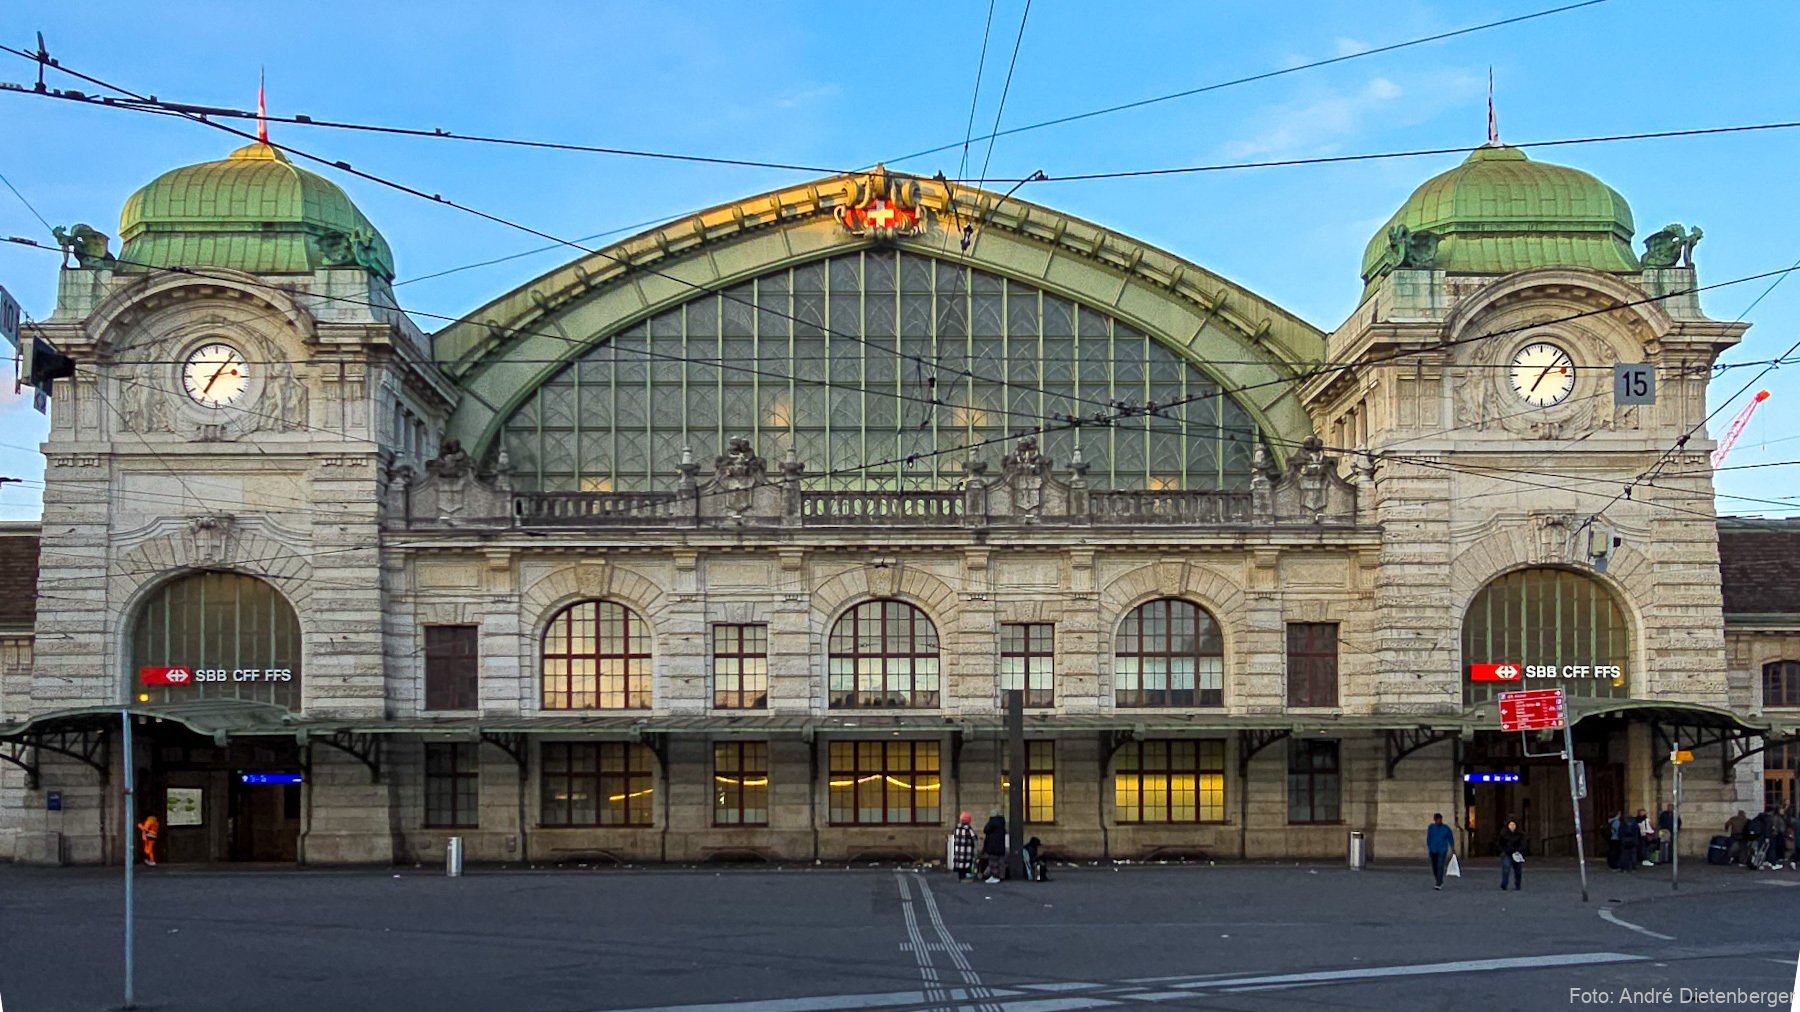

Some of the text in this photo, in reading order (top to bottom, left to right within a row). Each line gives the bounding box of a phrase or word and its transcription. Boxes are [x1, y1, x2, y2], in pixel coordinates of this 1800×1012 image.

[3, 299, 14, 333] 10
[1622, 371, 1648, 397] 15
[195, 669, 292, 682] SBB CFF FFS
[1526, 666, 1621, 679] SBB CFF FFS
